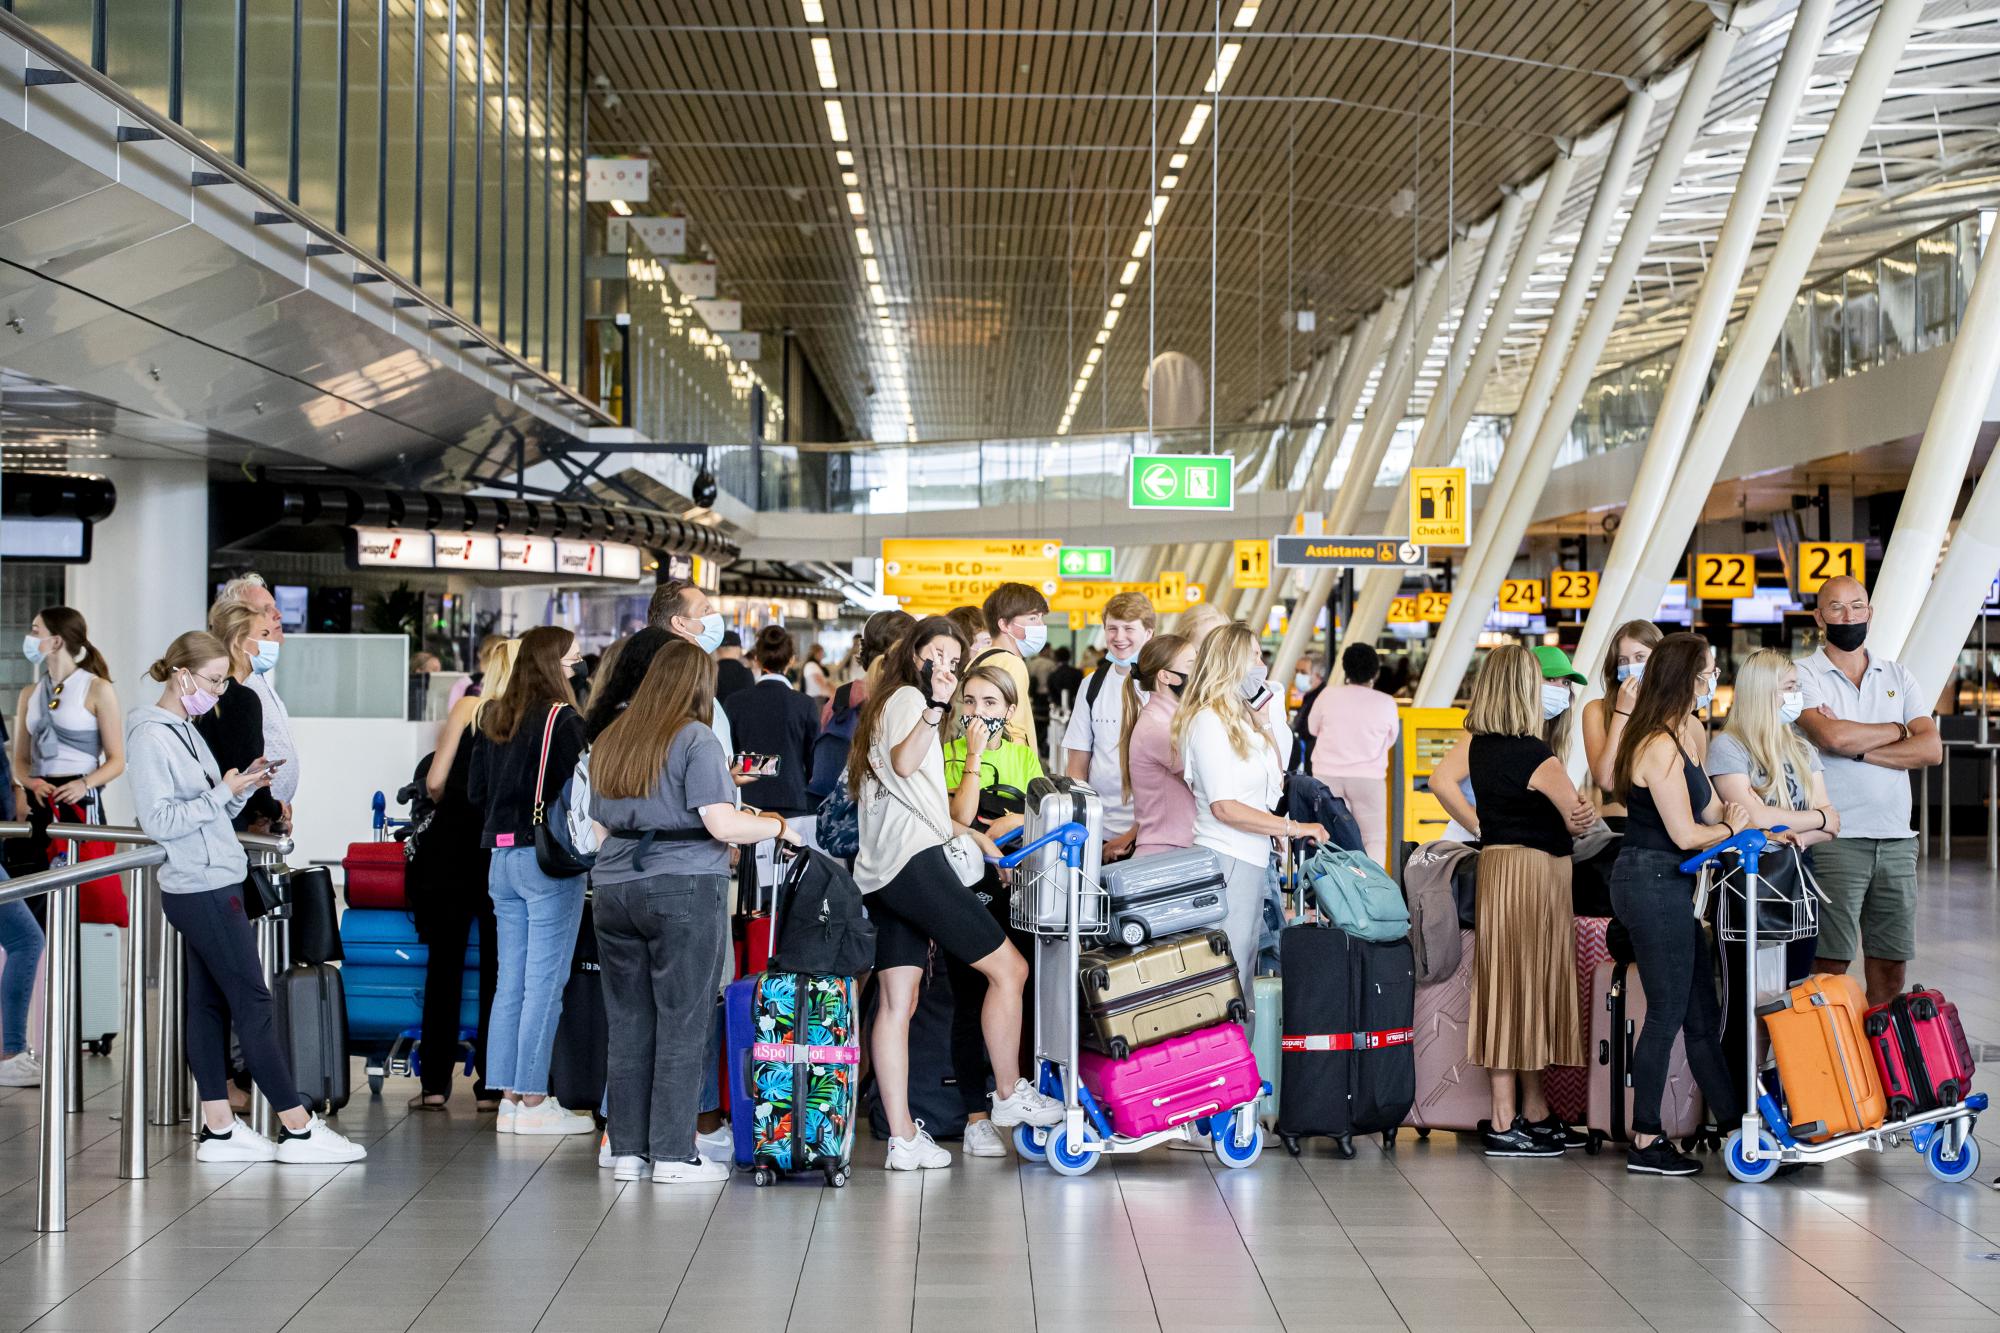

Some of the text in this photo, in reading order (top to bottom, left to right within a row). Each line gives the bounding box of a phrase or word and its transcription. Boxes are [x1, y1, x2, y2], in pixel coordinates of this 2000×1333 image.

[1416, 526, 1460, 536] Check-in
[1011, 544, 1026, 556] M
[1305, 544, 1376, 558] Assistance
[1704, 558, 1747, 587] 22
[1810, 547, 1854, 580] 21
[1504, 583, 1536, 605] 24
[1557, 575, 1592, 599] 23
[1392, 600, 1417, 617] 26
[1424, 596, 1449, 615] 25
